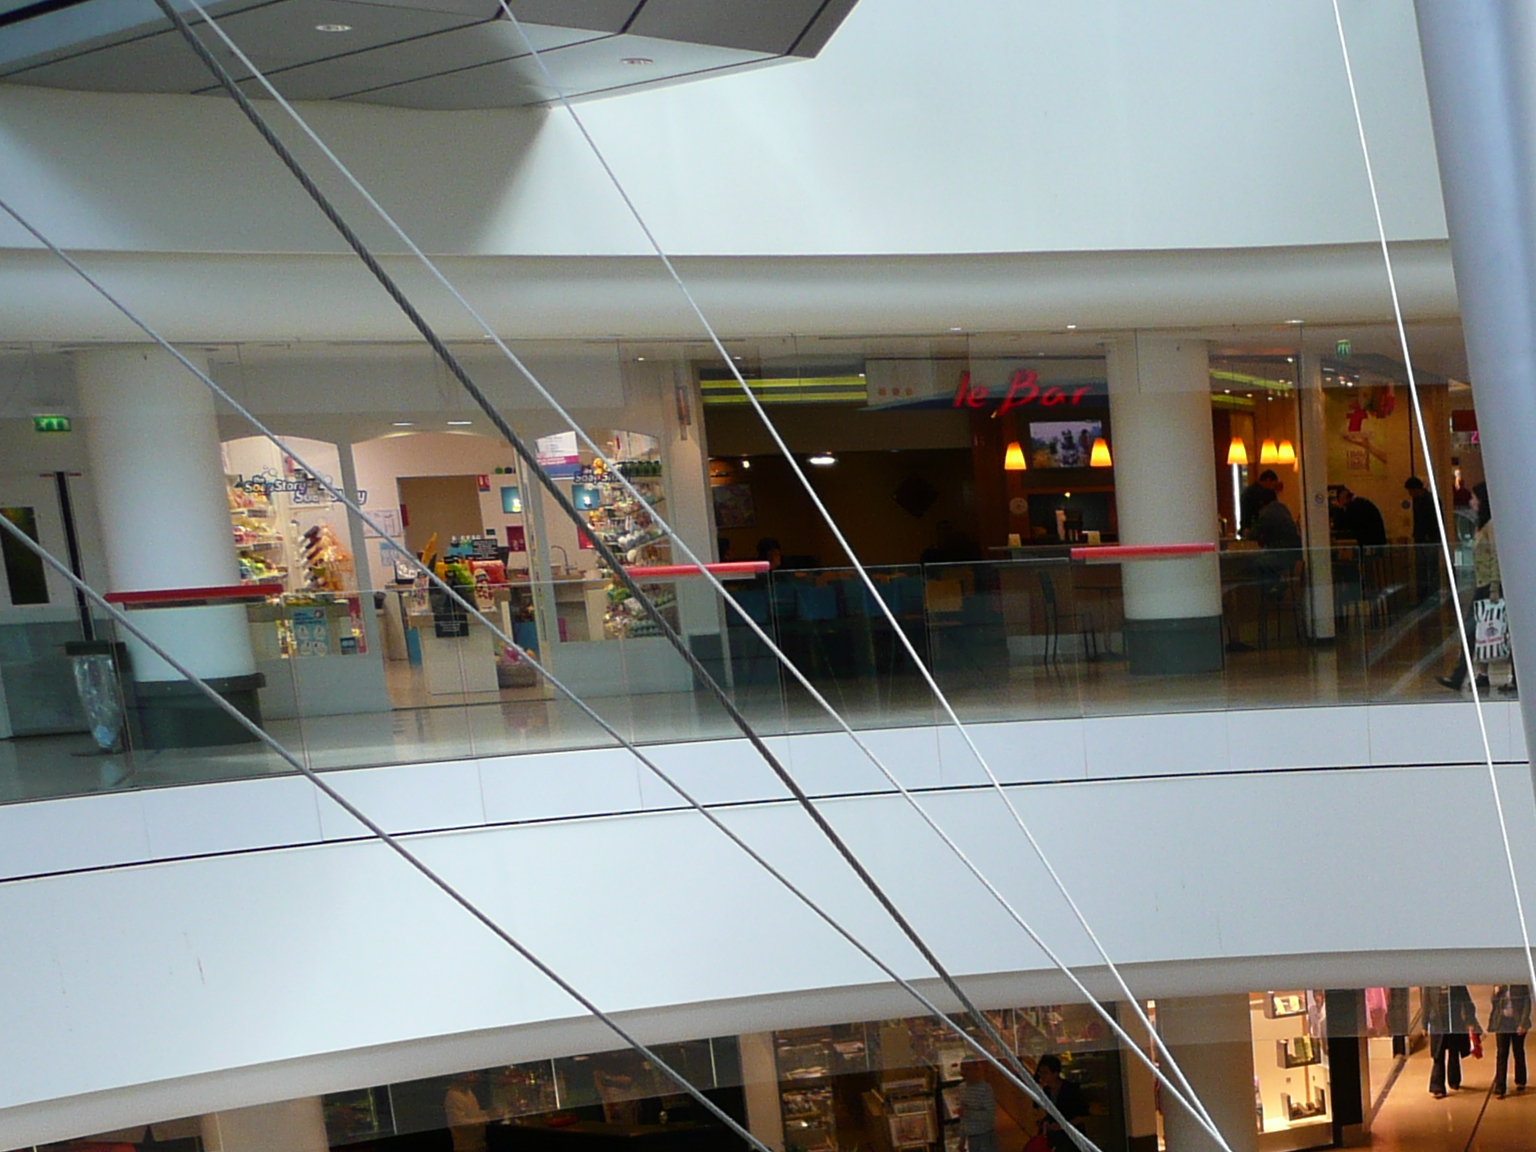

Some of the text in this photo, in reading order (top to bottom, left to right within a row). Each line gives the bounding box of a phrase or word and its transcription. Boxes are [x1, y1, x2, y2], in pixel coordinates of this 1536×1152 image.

[954, 370, 1092, 415] le Bar
[274, 479, 307, 495] Story
